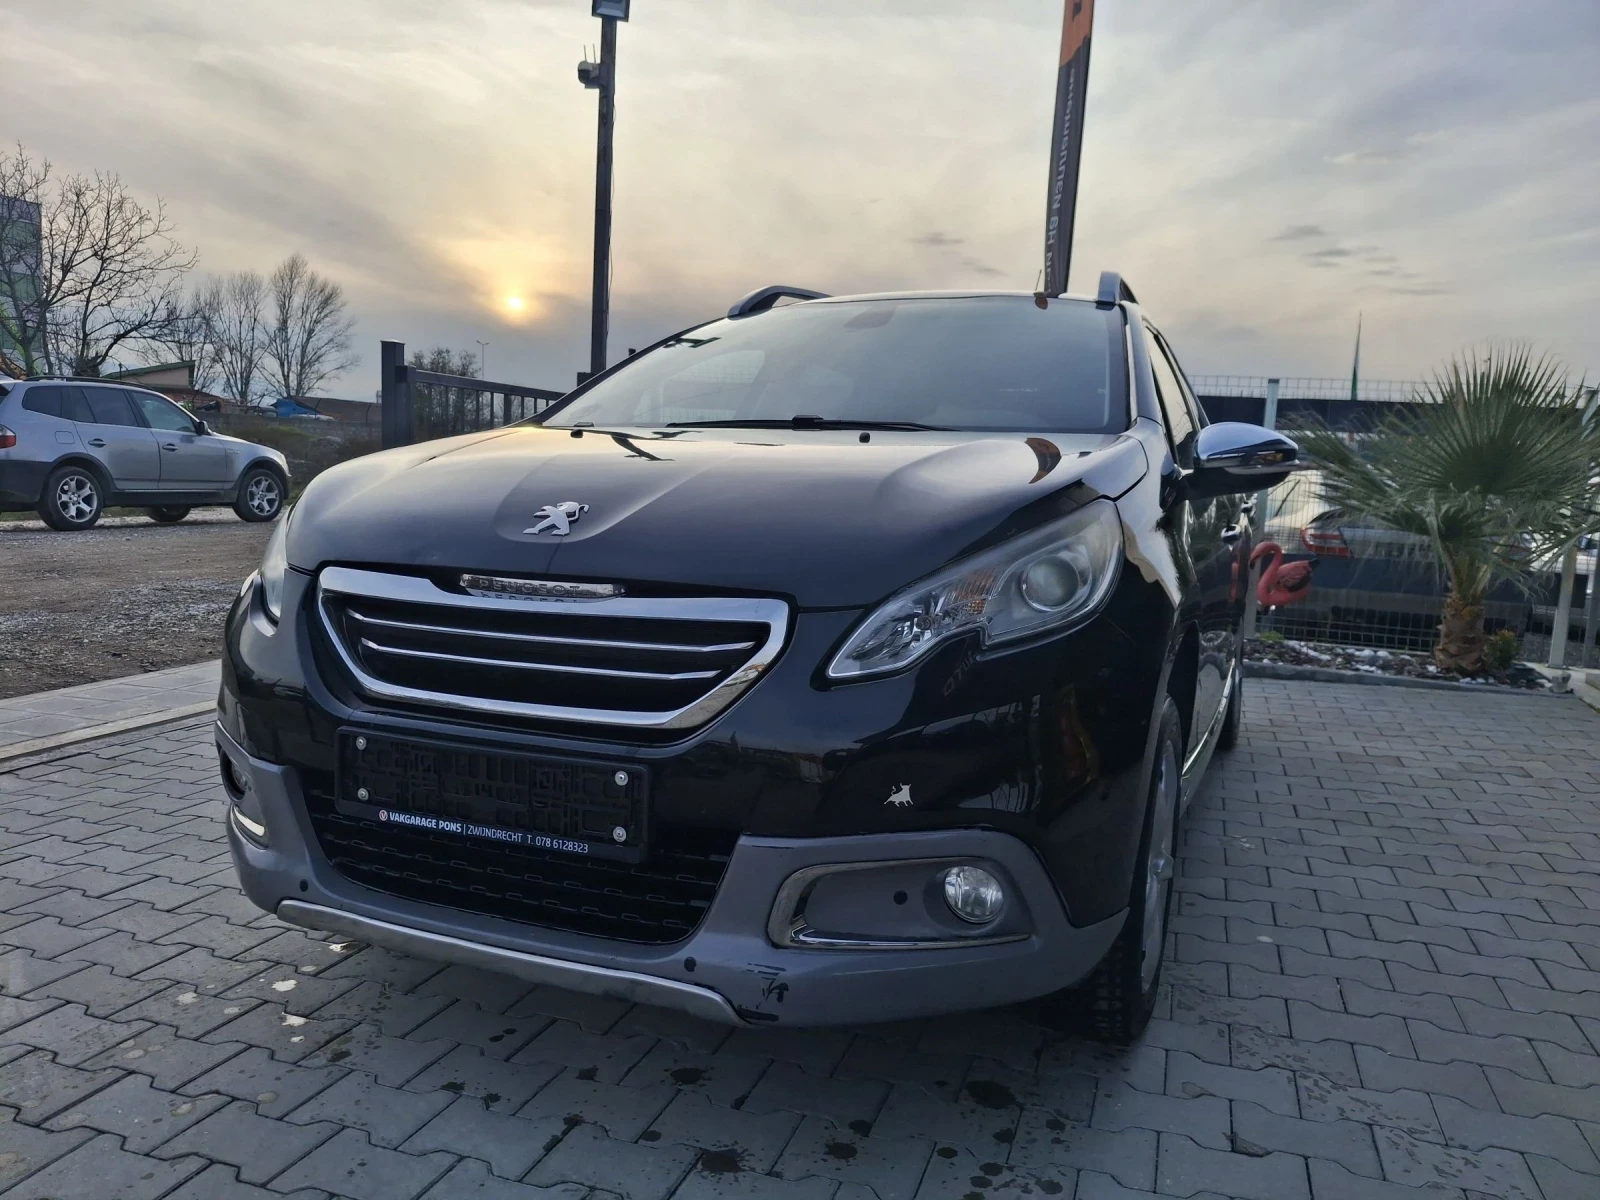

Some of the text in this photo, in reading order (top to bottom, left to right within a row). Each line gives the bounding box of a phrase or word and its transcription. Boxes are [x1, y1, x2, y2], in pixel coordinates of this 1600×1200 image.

[479, 578, 580, 596] PEUGEOT
[389, 811, 437, 829] VAKGARAGE
[439, 820, 462, 833] PONS
[467, 824, 523, 843] ZWIJNDRECHT
[526, 834, 534, 845] T.
[535, 836, 551, 848] 078
[552, 839, 589, 854] 6128323
